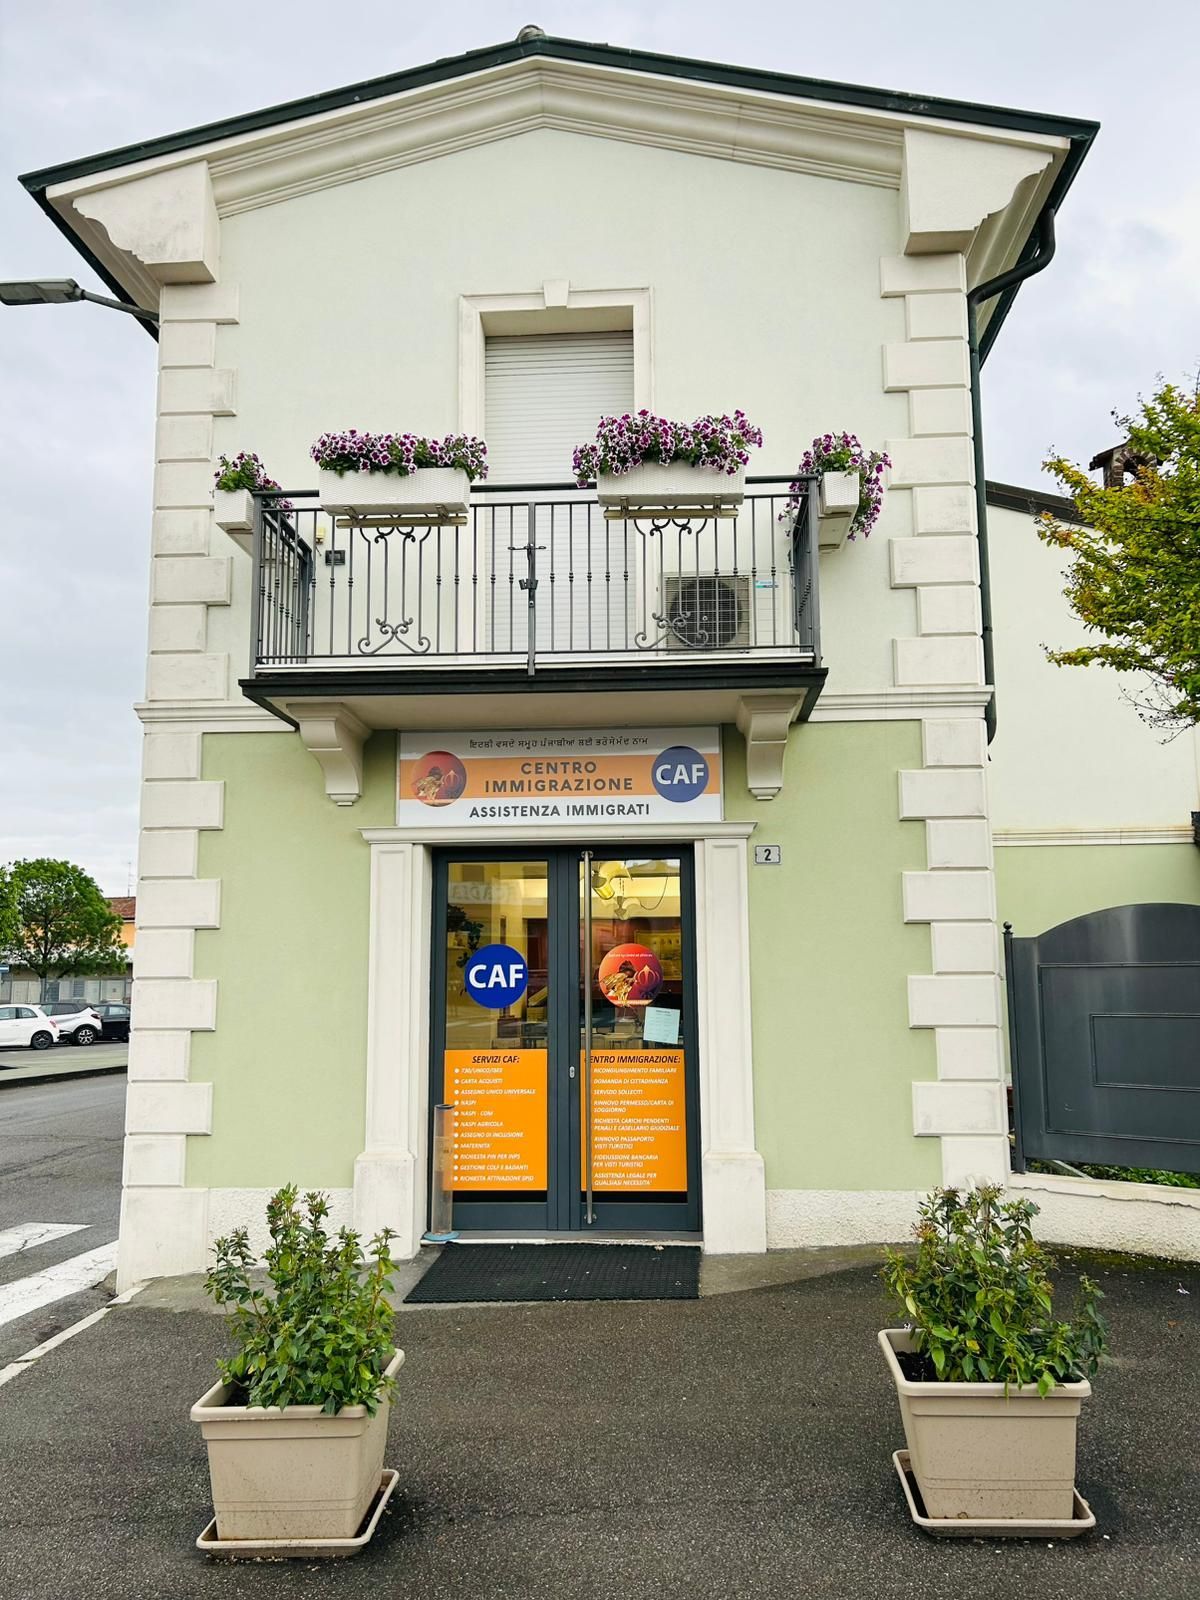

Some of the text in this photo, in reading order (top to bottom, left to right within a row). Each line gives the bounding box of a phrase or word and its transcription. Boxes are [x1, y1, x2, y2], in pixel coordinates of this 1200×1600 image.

[521, 761, 597, 775] CENTRO
[656, 764, 705, 785] CAF
[485, 778, 633, 793] IMMIGRAZIONE
[469, 804, 650, 818] ASSISTENZA IMMIGRATI
[764, 848, 771, 861] 2
[469, 964, 523, 989] CAF
